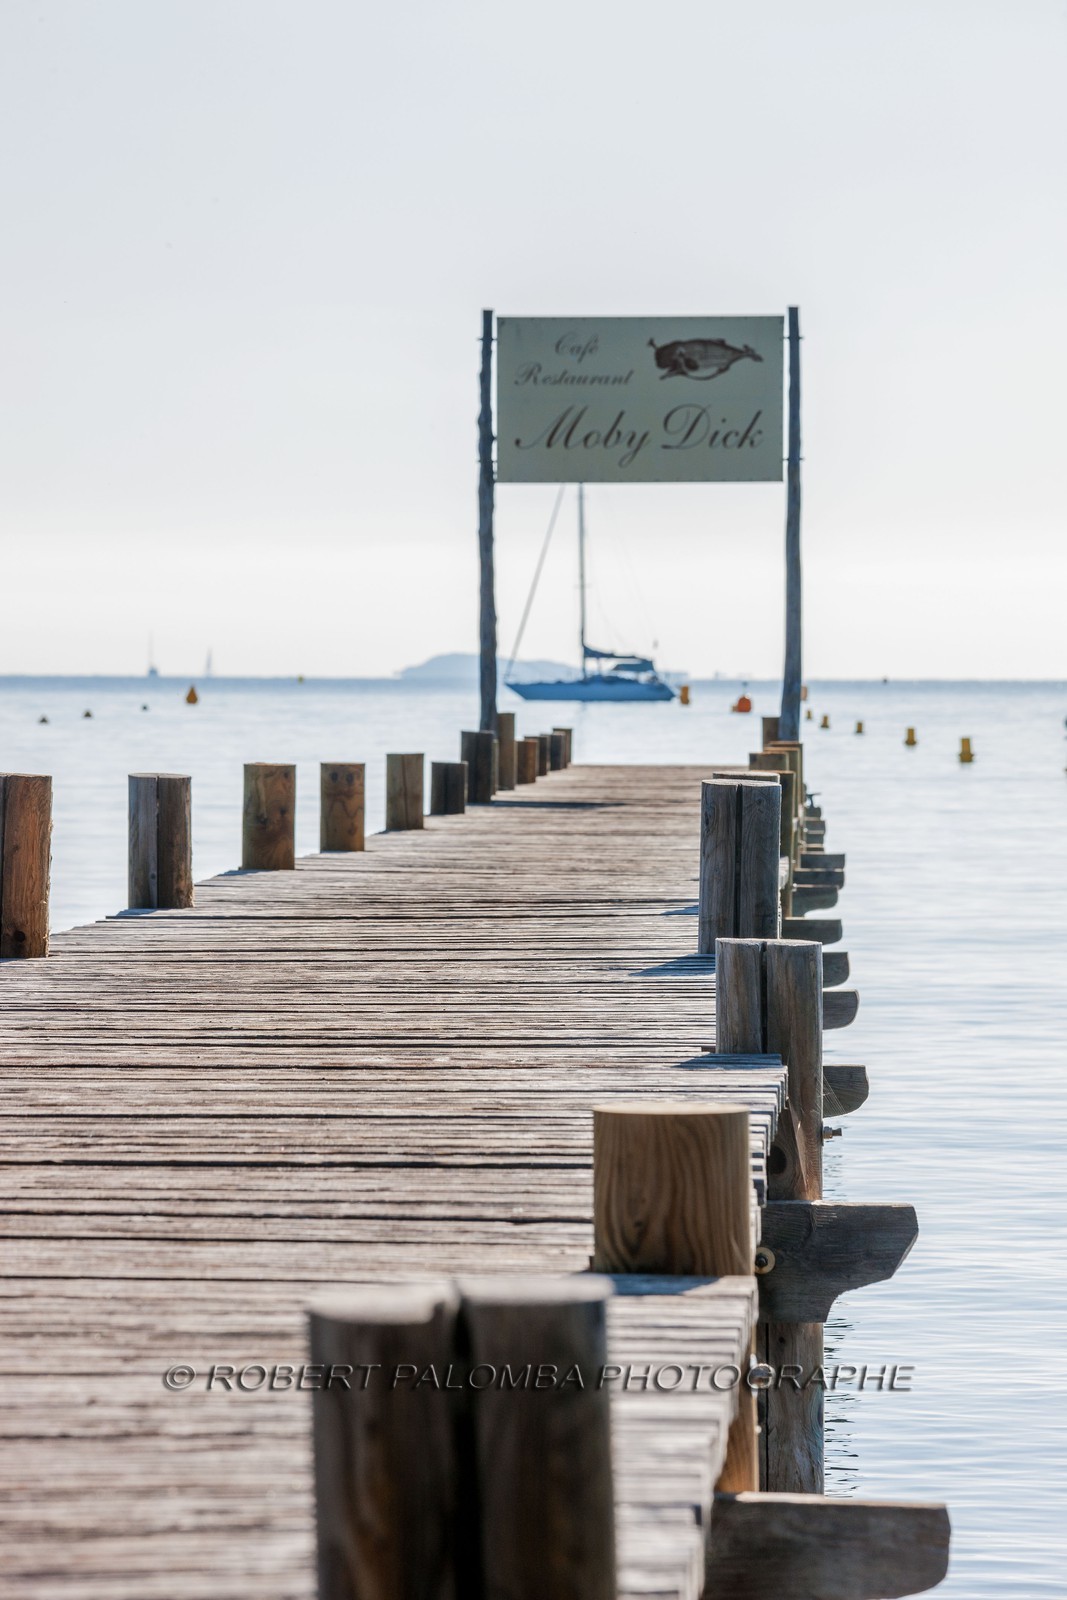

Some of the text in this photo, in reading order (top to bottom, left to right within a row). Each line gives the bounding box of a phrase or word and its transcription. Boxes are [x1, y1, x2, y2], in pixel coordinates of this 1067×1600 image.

[554, 333, 600, 364] Café
[514, 362, 634, 386] Restaurant
[514, 403, 764, 468] Moby Dick
